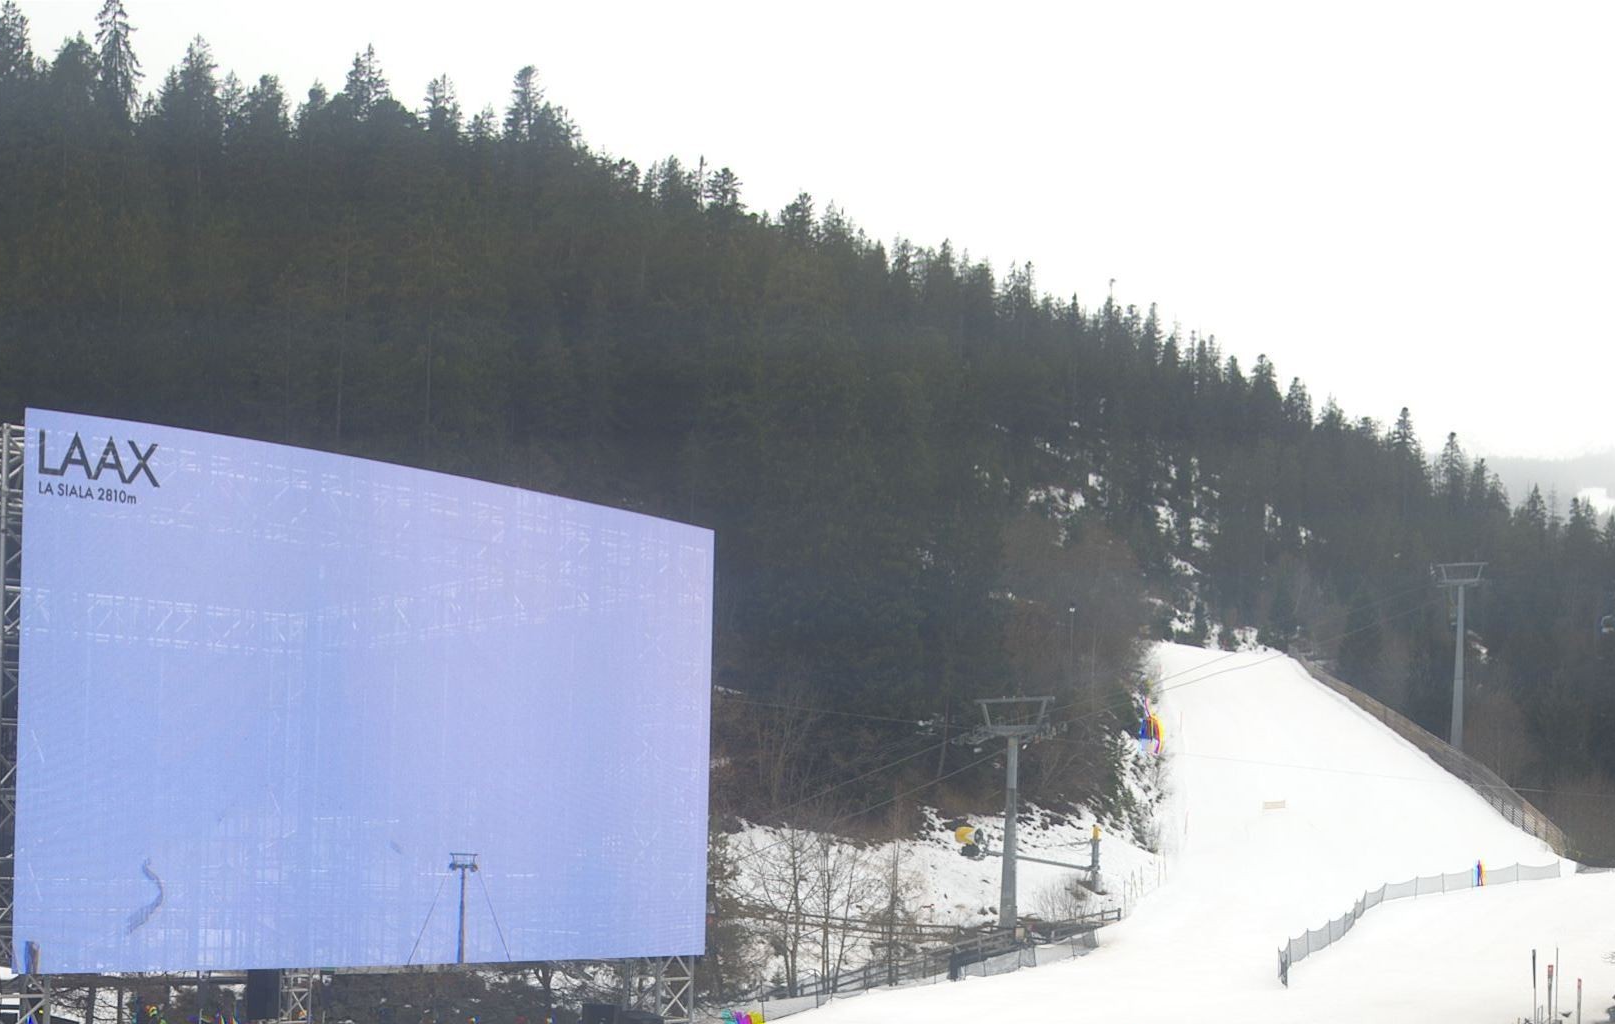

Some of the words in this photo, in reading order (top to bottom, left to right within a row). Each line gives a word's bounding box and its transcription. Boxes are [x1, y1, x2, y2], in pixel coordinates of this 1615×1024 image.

[38, 430, 160, 488] LAAX
[38, 481, 53, 494] LA
[57, 483, 94, 499] SIALA
[97, 487, 137, 504] 2810m
